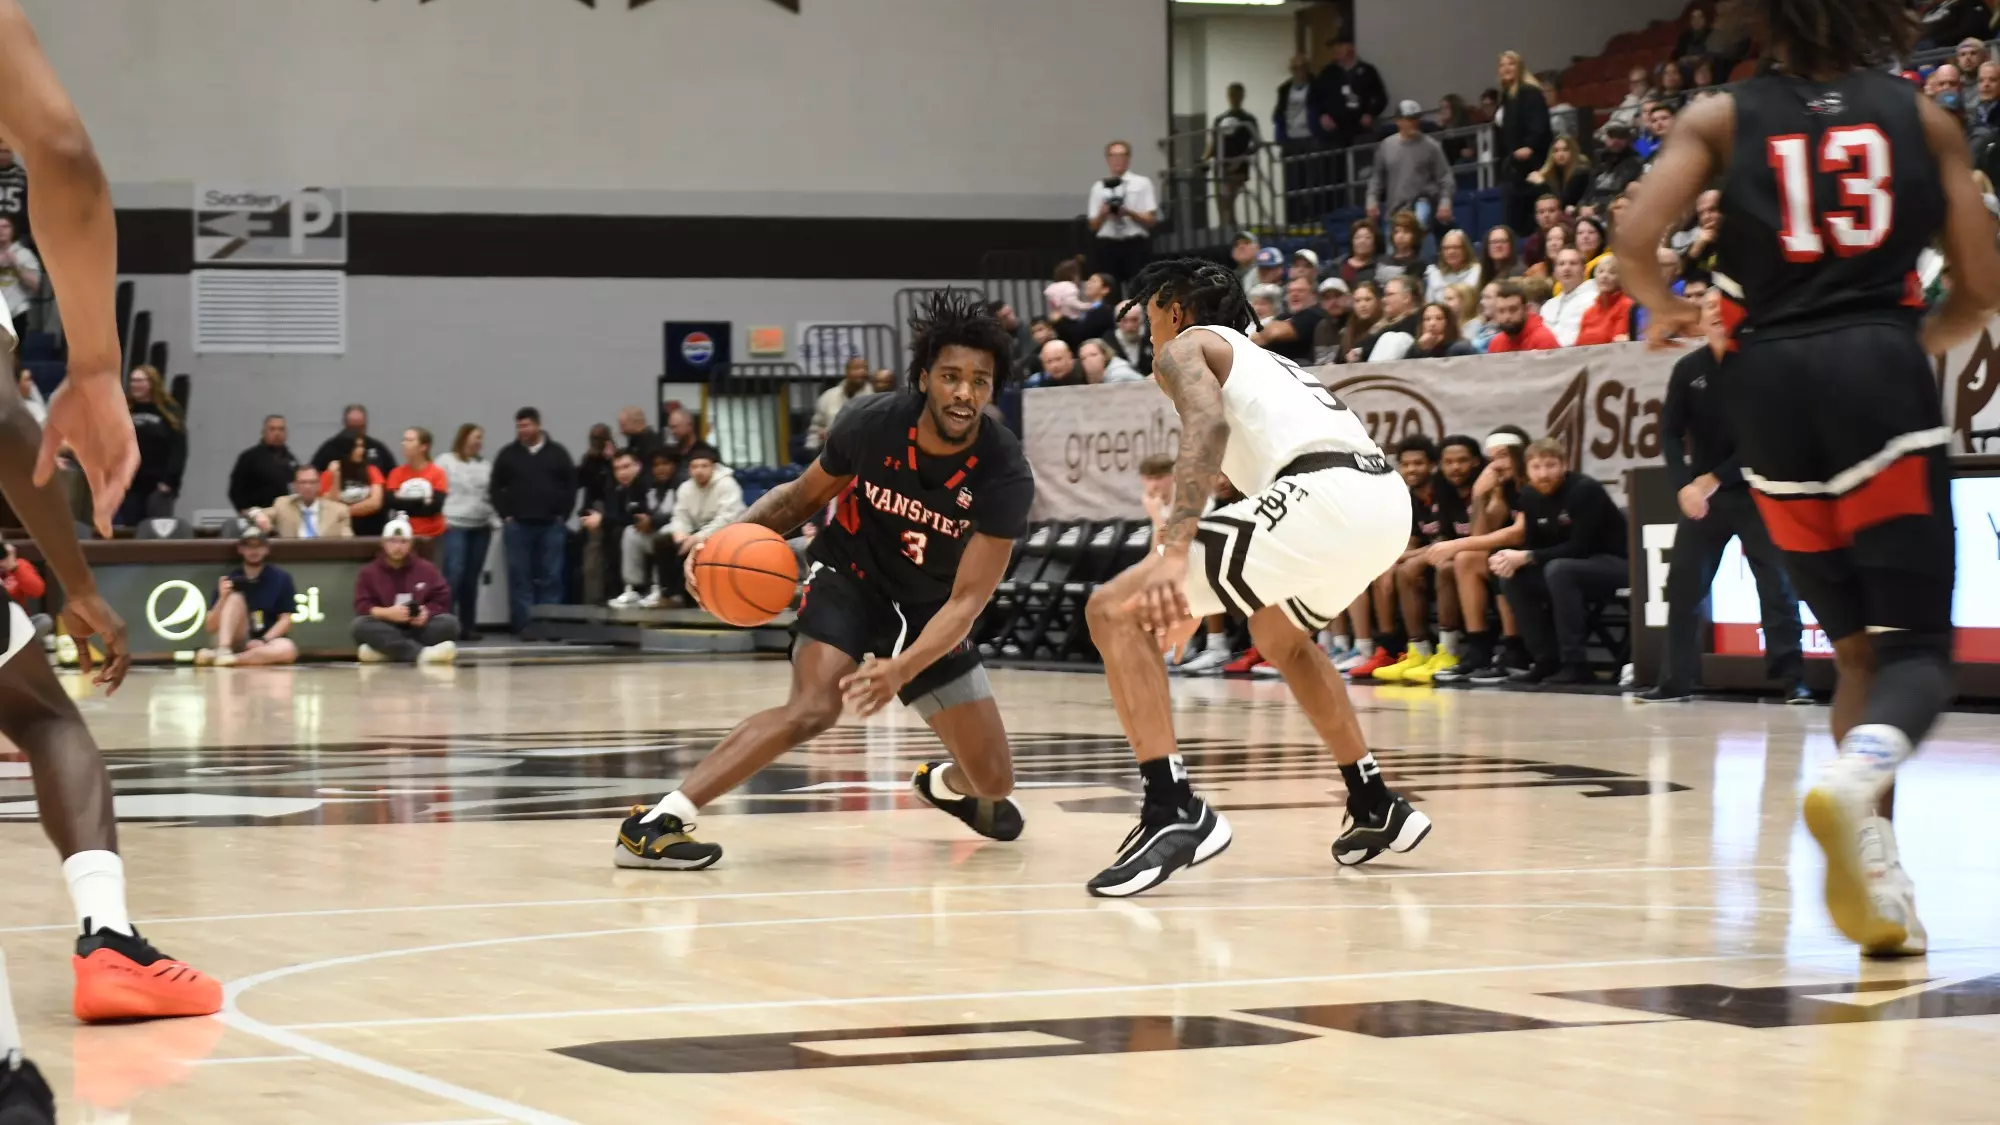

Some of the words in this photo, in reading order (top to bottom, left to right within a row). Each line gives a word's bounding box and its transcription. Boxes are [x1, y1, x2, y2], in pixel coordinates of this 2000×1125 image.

[204, 190, 283, 208] Section
[290, 191, 334, 255] P
[1766, 123, 1894, 263] 13
[1590, 379, 1664, 460] Sta
[900, 529, 928, 566] 3
